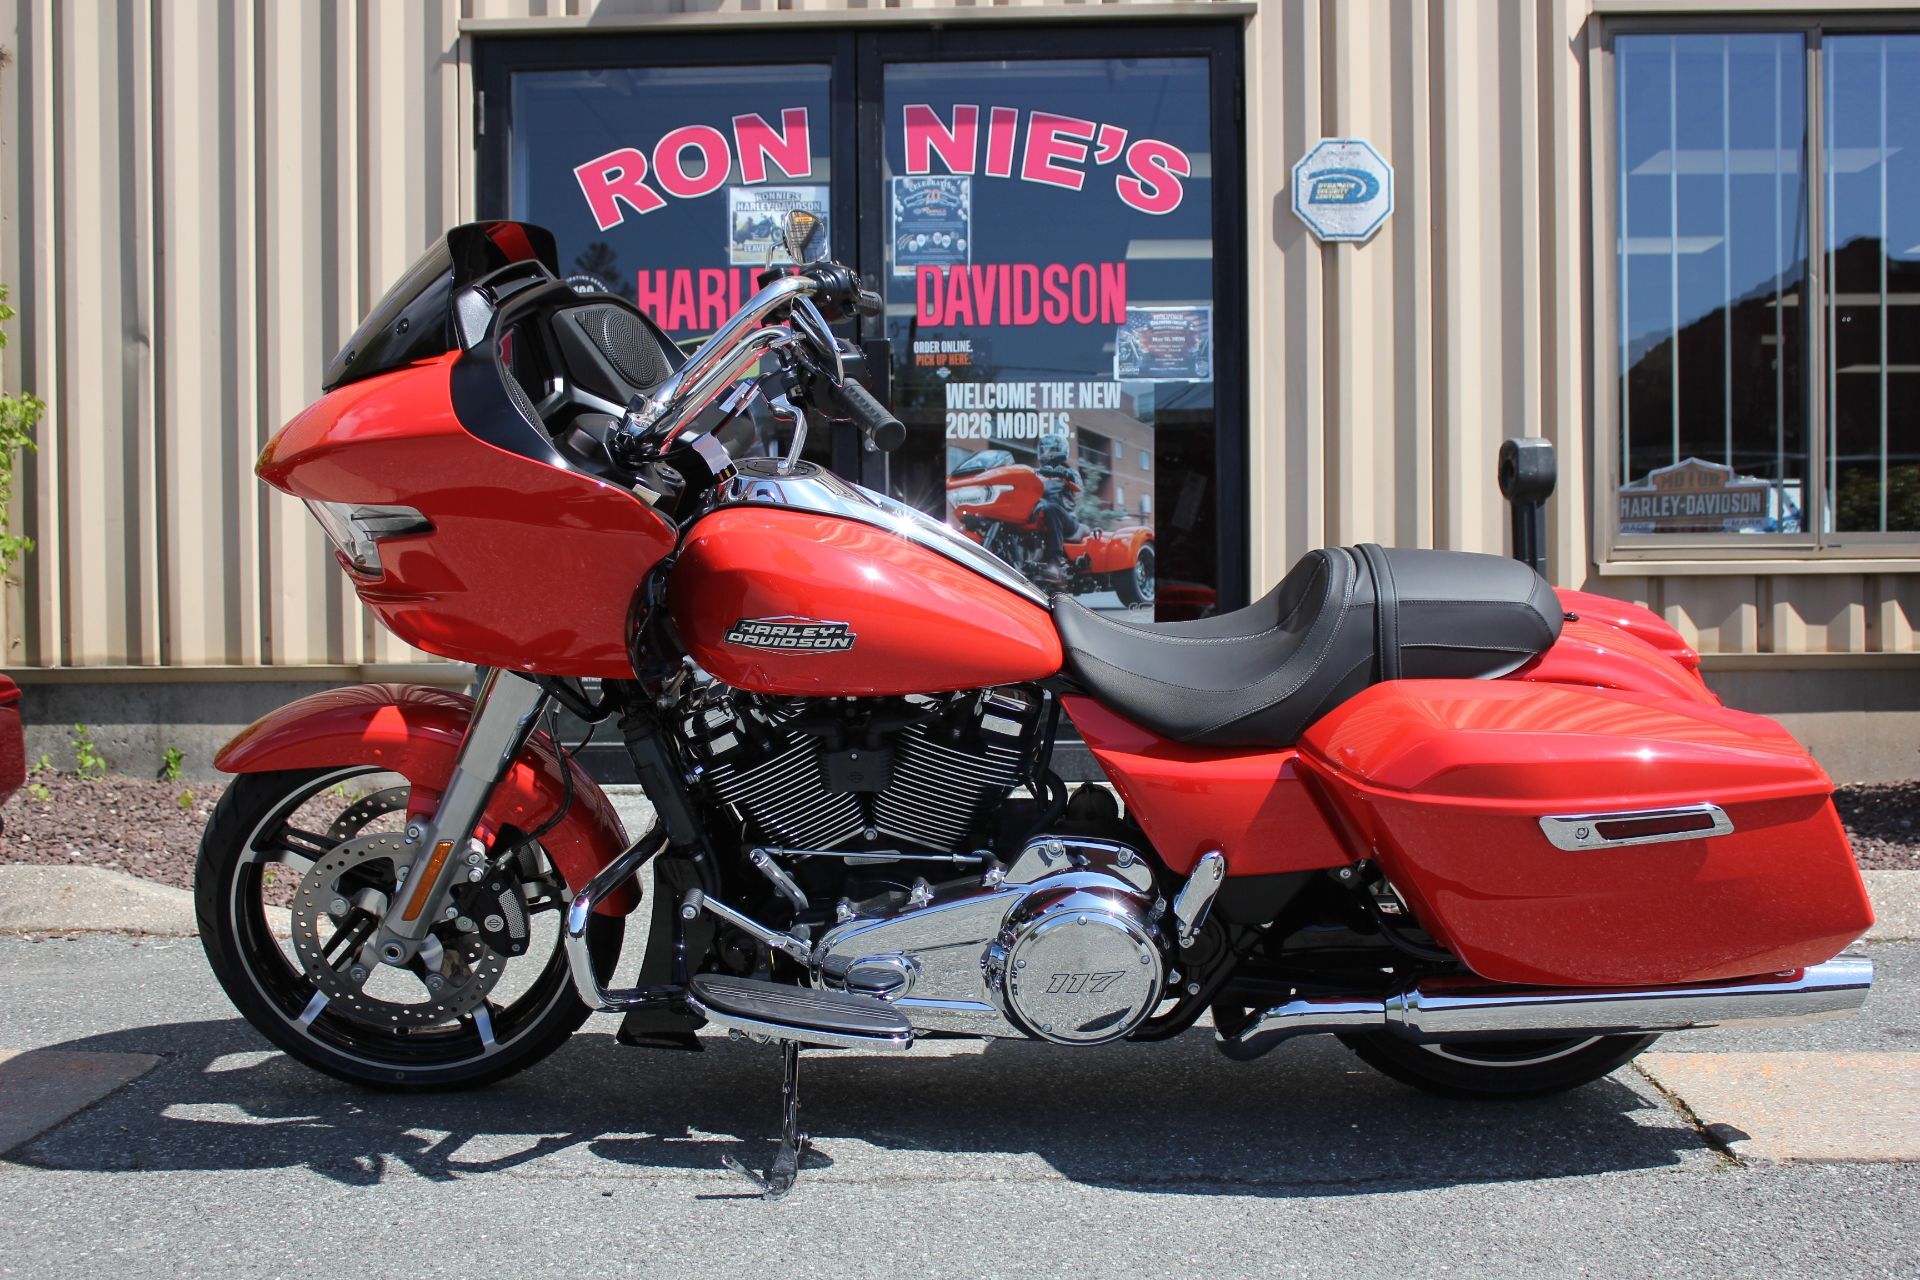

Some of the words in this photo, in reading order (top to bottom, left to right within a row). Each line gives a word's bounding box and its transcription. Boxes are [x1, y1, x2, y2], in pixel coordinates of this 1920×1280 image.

[573, 106, 812, 231] RON
[903, 104, 1191, 215] NIE'S
[755, 191, 801, 200] RONNIE'S
[916, 262, 1127, 326] DAVIDSON
[914, 341, 940, 353] ORDER
[942, 340, 973, 352] ONLINE.
[916, 354, 934, 366] PICK
[936, 354, 947, 365] UP
[949, 354, 971, 365] HERE.
[946, 383, 1036, 409] WELCOME
[1038, 382, 1077, 409] THE
[1079, 382, 1122, 409] NEW
[946, 413, 991, 439] 2026
[997, 412, 1075, 439] MODELS.
[1661, 471, 1720, 488] MOTOR
[1620, 492, 1761, 518] HARLEY-DAVIDSON
[1731, 519, 1763, 527] MARK
[728, 632, 850, 648] DAVIDSON
[1046, 970, 1126, 994] 117
